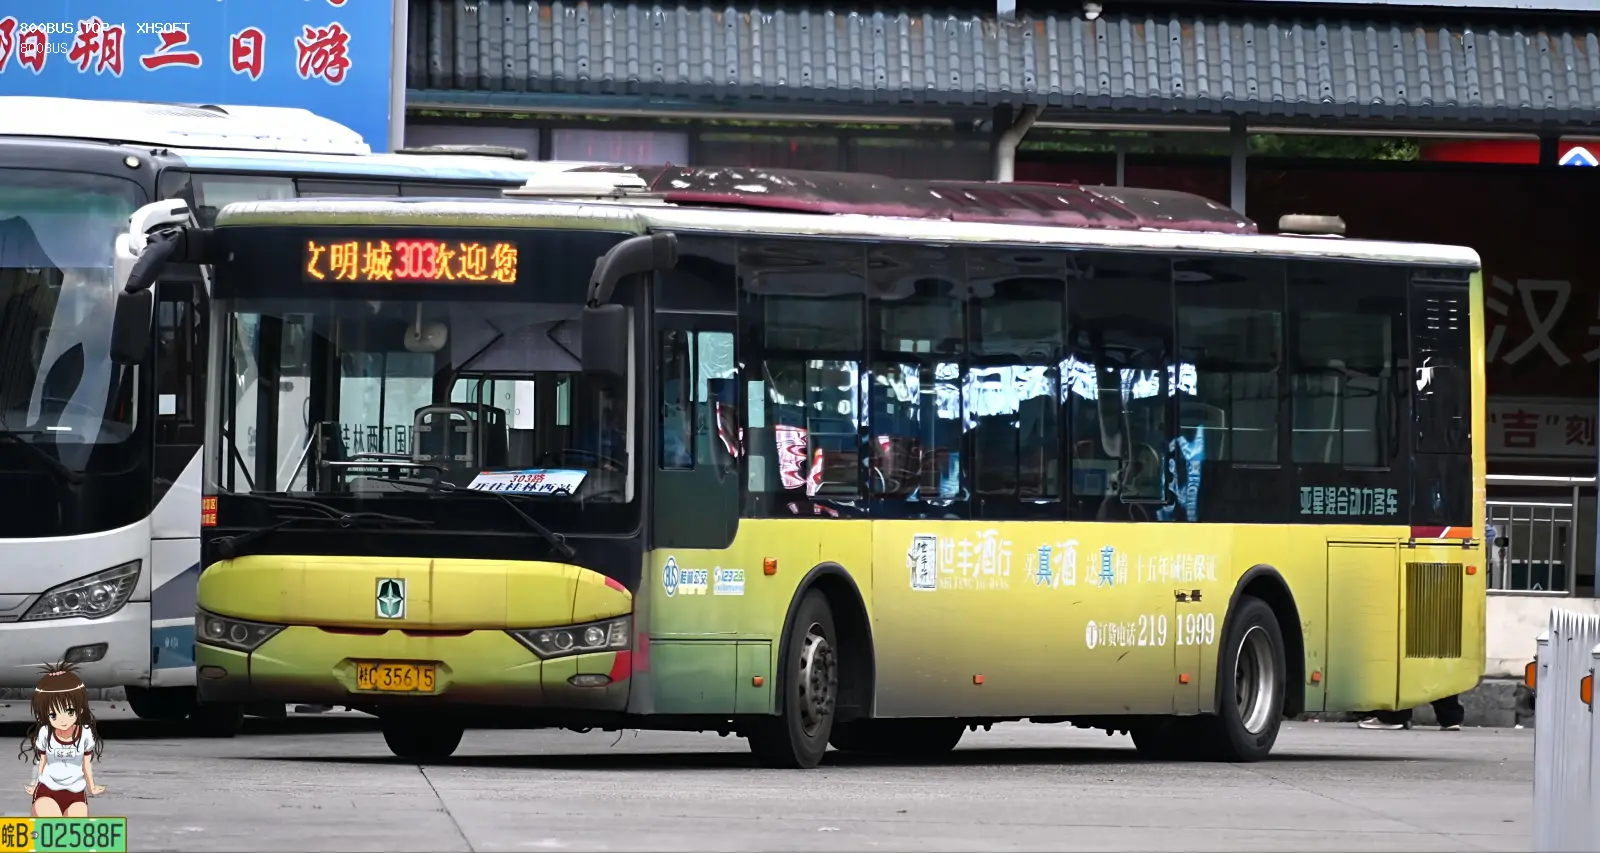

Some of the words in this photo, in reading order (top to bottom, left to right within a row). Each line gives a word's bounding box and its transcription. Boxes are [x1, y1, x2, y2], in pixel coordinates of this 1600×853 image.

[0, 16, 353, 85] 阳朔二日游
[1485, 275, 1600, 367] 汉
[509, 473, 546, 483] 303路
[1300, 486, 1398, 516] 亚星混合动力客车
[940, 528, 1012, 578] 世丰酒行
[1024, 539, 1078, 589] 买真酒
[1085, 544, 1127, 587] 送真情
[1099, 622, 1136, 647] 订货电话
[1138, 614, 1167, 647] 219
[1176, 613, 1215, 646] 1999
